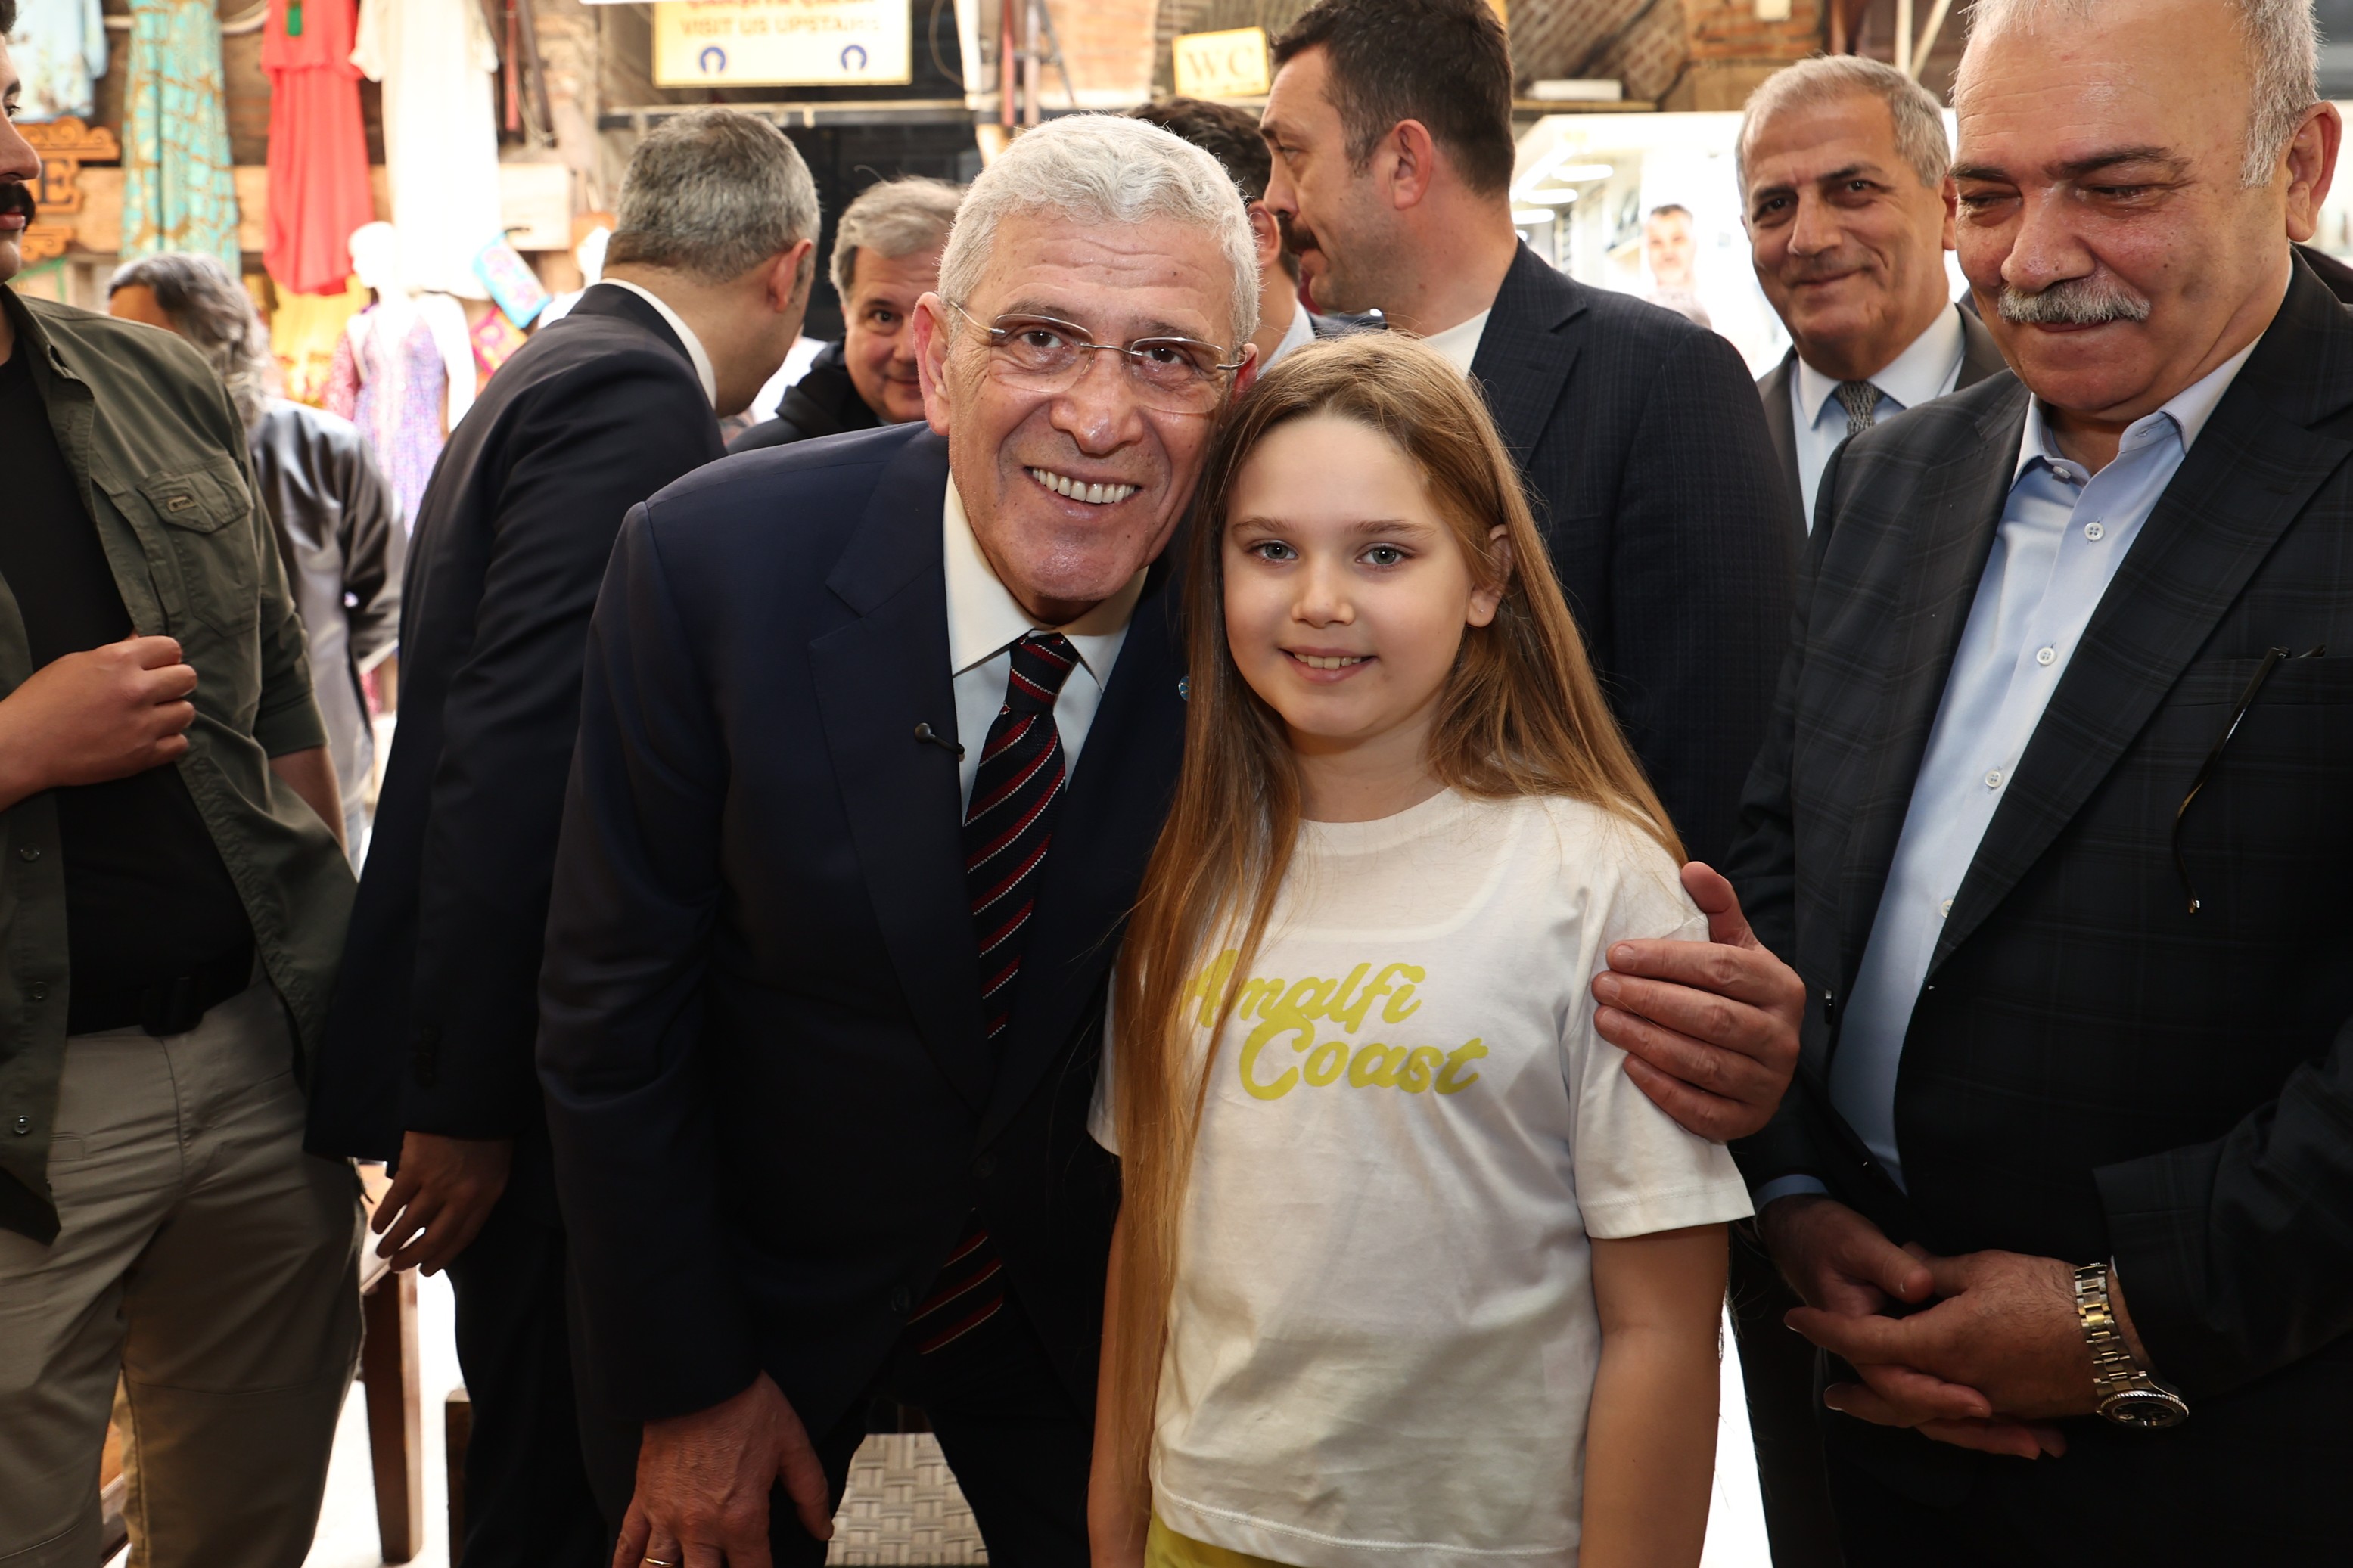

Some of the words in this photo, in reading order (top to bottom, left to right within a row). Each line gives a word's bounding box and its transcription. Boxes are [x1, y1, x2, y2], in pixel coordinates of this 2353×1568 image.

[679, 17, 734, 36] VISIT
[738, 16, 769, 36] US
[1184, 46, 1254, 79] WC
[1239, 1014, 1488, 1101] Coast
